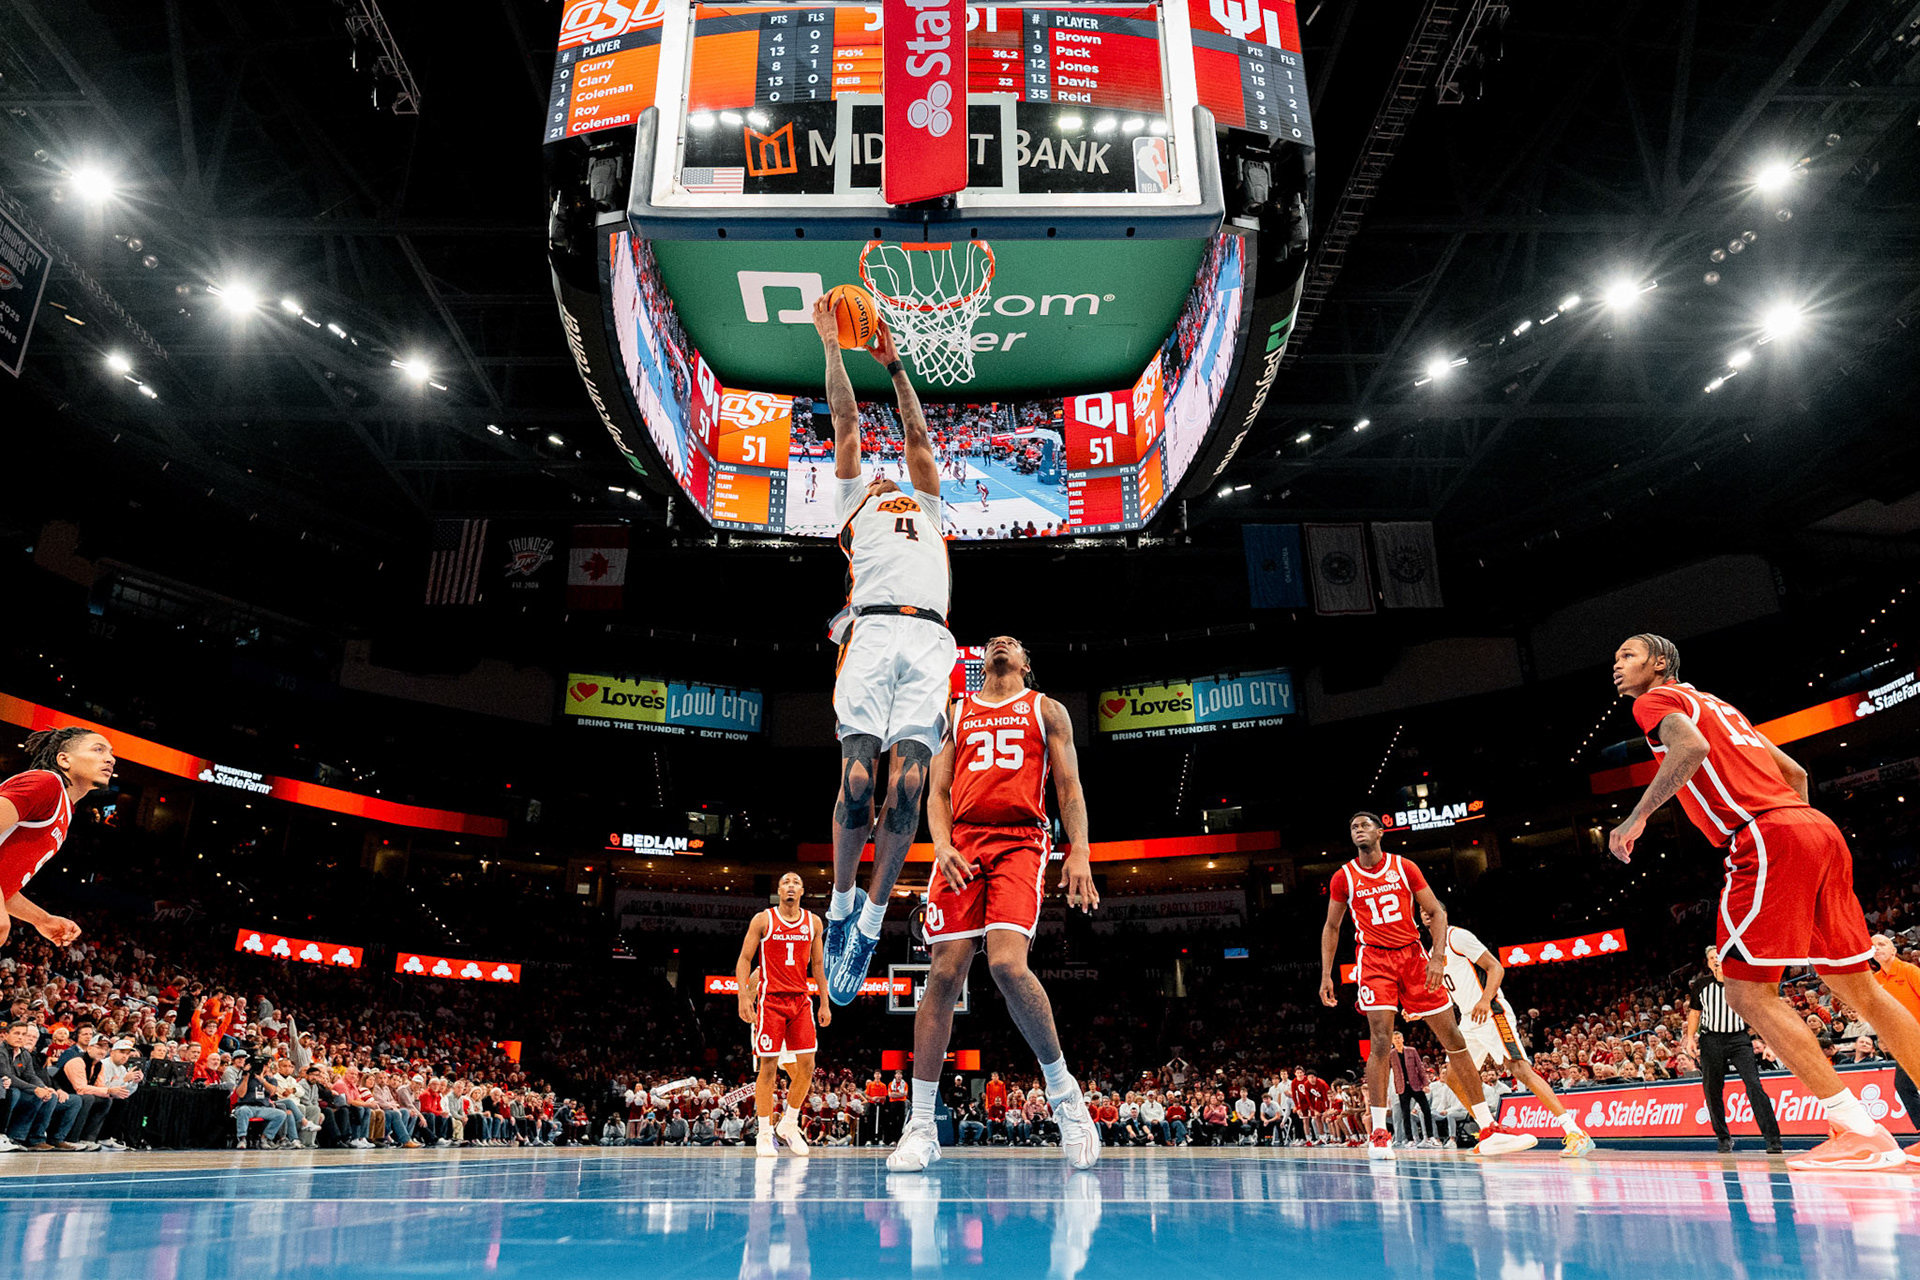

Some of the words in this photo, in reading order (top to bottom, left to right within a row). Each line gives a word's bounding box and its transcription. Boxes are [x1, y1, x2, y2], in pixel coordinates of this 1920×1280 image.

[770, 15, 788, 25] PTS
[808, 13, 825, 22] FLS
[1056, 16, 1099, 30] PLAYER
[773, 32, 783, 42] 4
[810, 30, 820, 40] 0
[1034, 30, 1040, 39] 1
[1055, 31, 1102, 45] Brown
[582, 40, 621, 58] PLAYER
[770, 46, 785, 56] 13
[810, 44, 820, 54] 2
[837, 50, 864, 58] FG%
[992, 50, 1018, 59] 36.2
[1033, 45, 1042, 54] 9
[1056, 46, 1091, 58] Pack
[1247, 46, 1264, 57] PTS
[1280, 54, 1296, 66] FLS
[560, 69, 570, 79] 0
[579, 58, 615, 74] Curry
[772, 62, 782, 71] 8
[811, 59, 817, 68] 1
[836, 63, 854, 71] TO
[1001, 62, 1010, 72] 7
[1030, 59, 1046, 69] 12
[1056, 60, 1100, 74] Jones
[1248, 62, 1265, 73] 10
[1286, 70, 1292, 80] 1
[560, 84, 566, 93] 1
[578, 74, 612, 88] Clary
[768, 76, 784, 86] 13
[808, 74, 818, 84] 0
[836, 76, 861, 85] REB
[998, 78, 1014, 86] 32
[1031, 74, 1046, 84] 13
[1057, 75, 1098, 88] Davis
[1251, 76, 1266, 86] 15
[1288, 84, 1294, 94] 1
[556, 98, 565, 108] 4
[576, 83, 634, 102] Coleman
[769, 92, 780, 102] 0
[810, 90, 816, 99] 1
[1030, 90, 1048, 100] 35
[1057, 90, 1092, 103] Reid
[1256, 90, 1265, 100] 9
[1288, 99, 1298, 109] 2
[554, 112, 563, 122] 9
[574, 104, 600, 118] Roy
[1258, 105, 1266, 116] 3
[1292, 114, 1298, 124] 1
[550, 126, 564, 138] 21
[571, 112, 630, 132] Coleman
[1260, 120, 1268, 130] 5
[1292, 128, 1301, 138] 0
[1141, 183, 1158, 193] NBA
[26, 247, 43, 270] CITY
[854, 296, 870, 340] Wilson
[698, 408, 710, 446] 51
[1144, 410, 1156, 446] 51
[742, 435, 766, 464] 51
[1090, 436, 1114, 465] 51
[718, 464, 737, 472] PLAYER
[770, 470, 780, 478] PTS
[894, 518, 919, 542] 4
[508, 536, 554, 554] THUNDER
[1198, 682, 1244, 718] LOUD
[1250, 681, 1290, 708] CITY
[1874, 682, 1920, 712] StateFar
[670, 692, 715, 719] LOUD
[721, 695, 759, 727] CITY
[577, 718, 611, 728] BRING
[614, 721, 634, 730] THE
[636, 724, 686, 735] THUNDER
[700, 730, 723, 739] EXIT
[725, 732, 748, 741] NOW
[962, 715, 1030, 730] OKLAHOMA
[1112, 732, 1144, 741] BRING
[1145, 728, 1166, 738] THE
[1168, 724, 1218, 736] THUNDER
[1232, 720, 1256, 730] EXIT
[1258, 718, 1284, 727] NOW
[966, 730, 1024, 772] 35
[1395, 802, 1468, 827] BEDLAM
[1411, 820, 1455, 832] BASKETBALL
[622, 833, 688, 851] BEDLAM
[634, 847, 674, 856] BASKETBALL
[1356, 882, 1402, 898] OKLAHOMA
[1160, 902, 1188, 914] PARTY
[1192, 900, 1236, 912] TERRACE
[1364, 893, 1403, 926] 12
[926, 902, 945, 932] OU
[772, 934, 809, 942] OKLAHOMA
[784, 942, 796, 966] 1
[1036, 970, 1099, 980] UNDER
[1360, 985, 1376, 1004] OU
[760, 1034, 772, 1051] OU
[724, 1084, 755, 1106] DEFENSE
